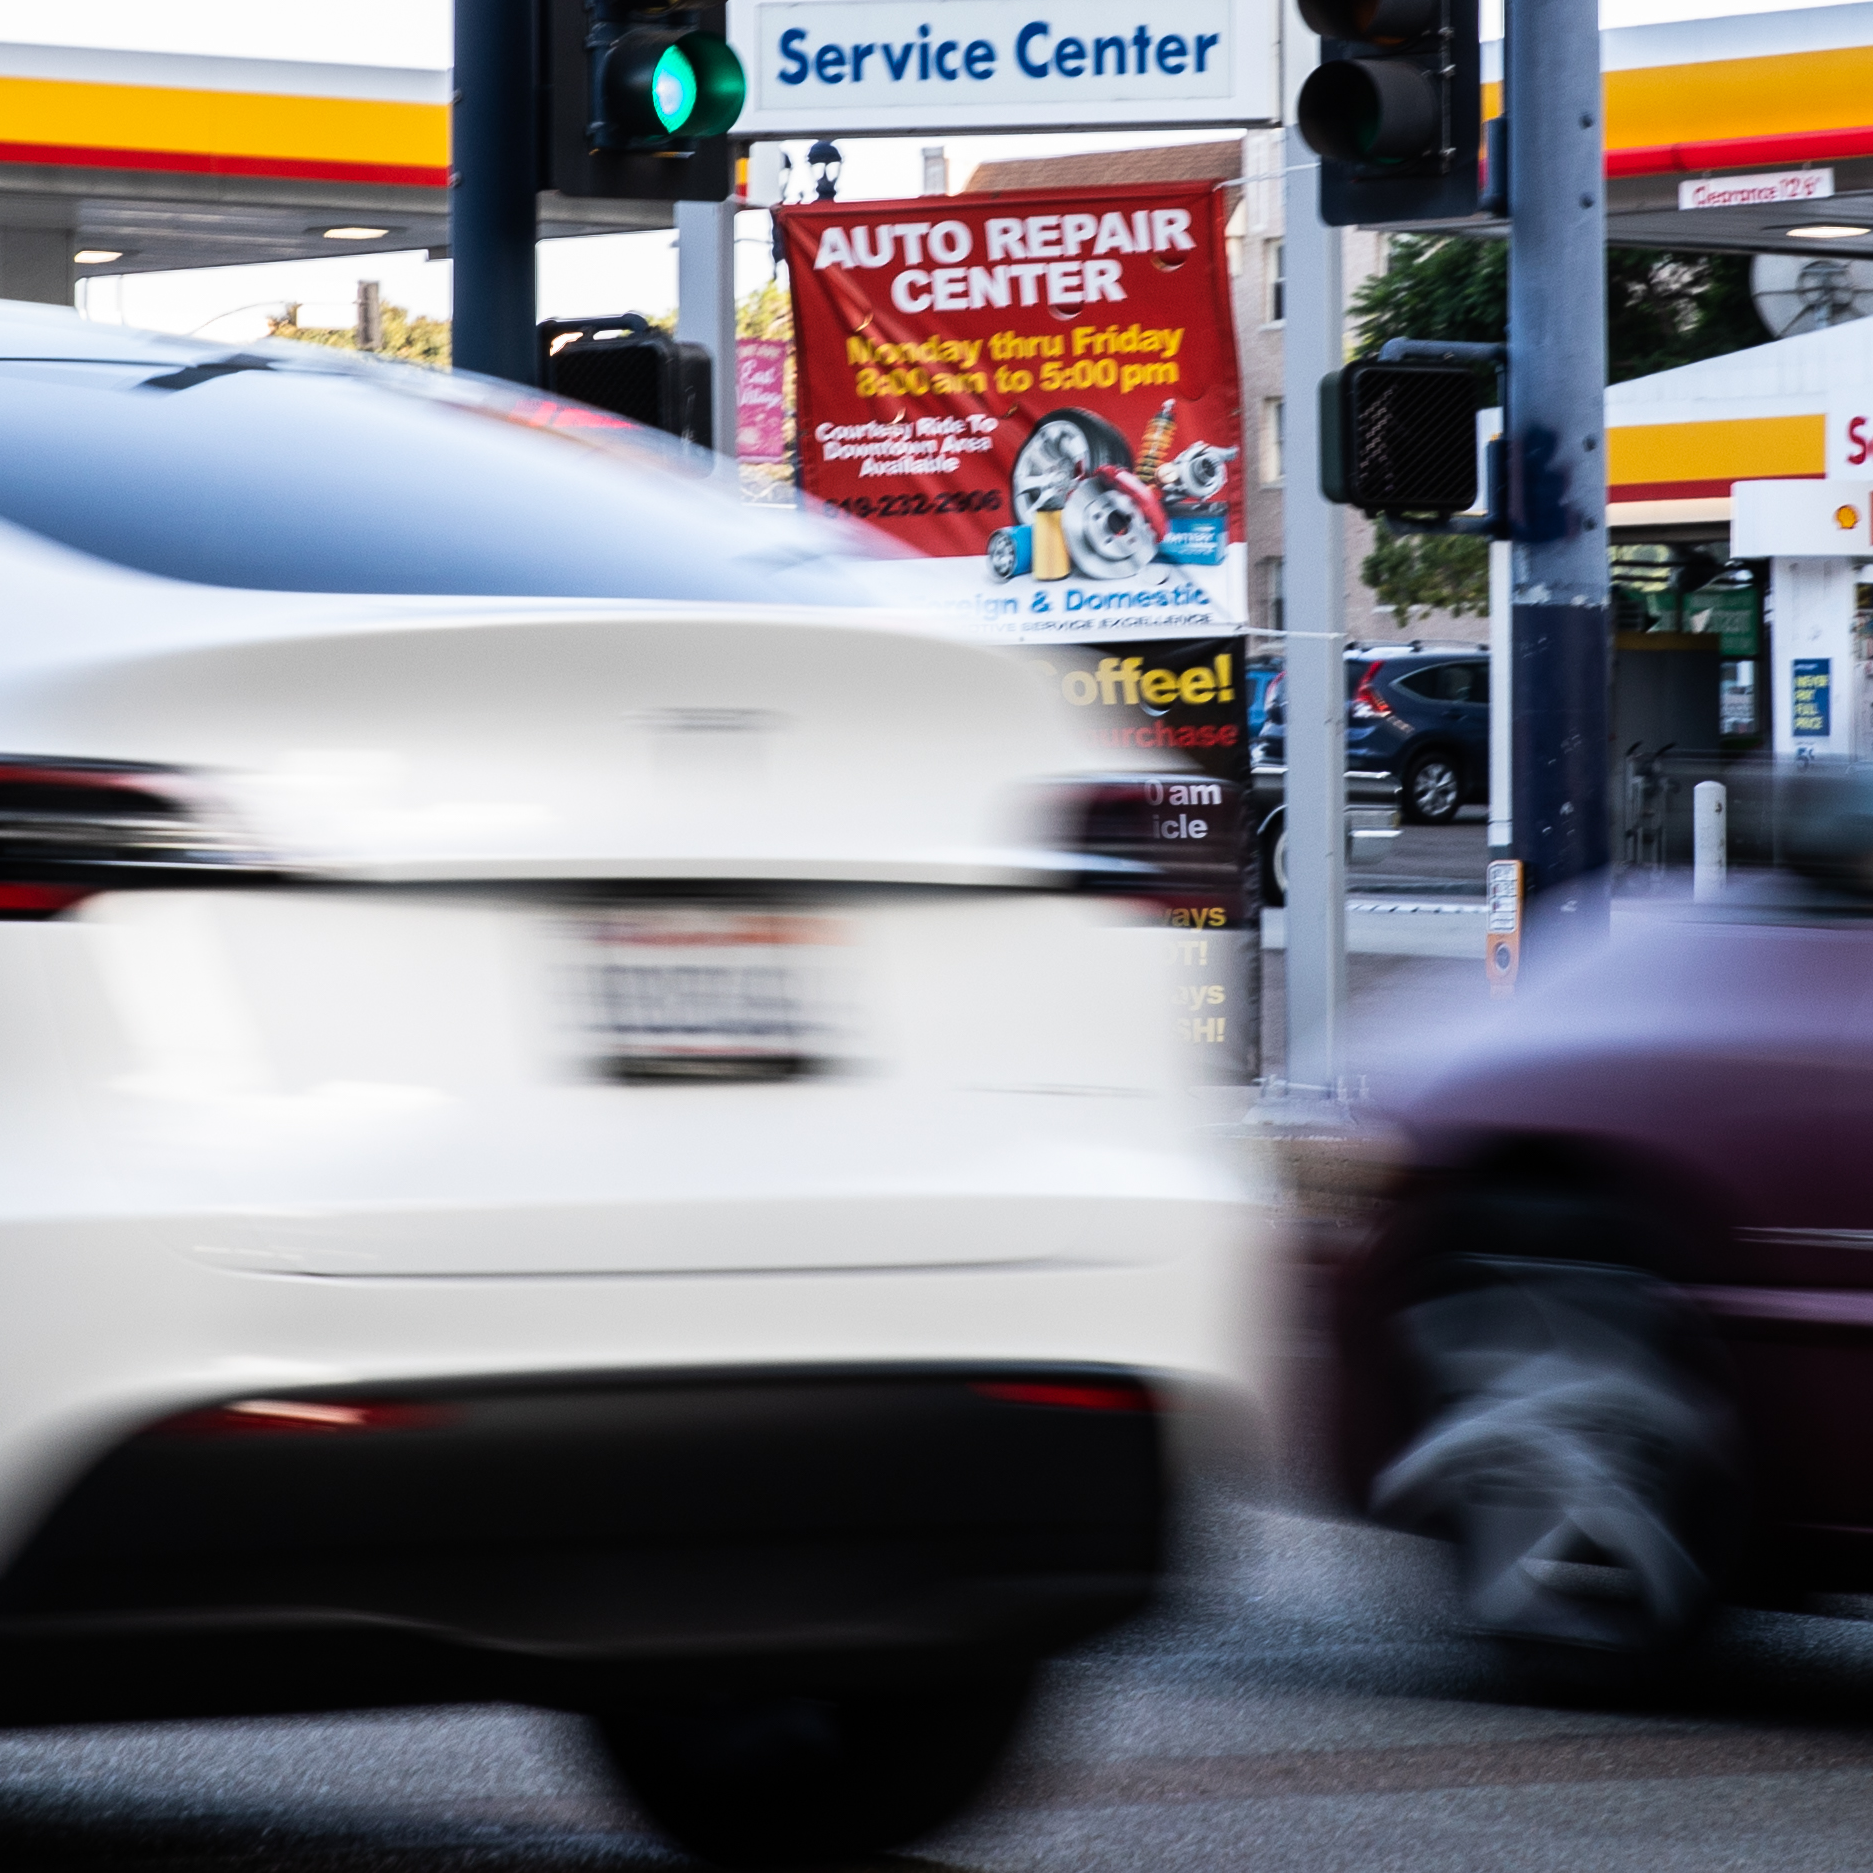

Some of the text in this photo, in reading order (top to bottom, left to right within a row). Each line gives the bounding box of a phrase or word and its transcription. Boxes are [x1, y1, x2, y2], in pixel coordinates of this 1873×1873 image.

[778, 22, 1220, 85] Service Center
[813, 208, 1197, 271] AUTO REPAIR
[890, 259, 1128, 315] CENTER
[845, 323, 1186, 370] Monday thru Friday
[930, 371, 988, 395] am
[993, 365, 1034, 394] to
[1039, 358, 1119, 392] 5:00
[1119, 360, 1180, 394] pm
[815, 419, 914, 443] Courtesy
[967, 413, 1000, 433] To
[940, 434, 994, 454] Area
[858, 453, 961, 479] Available
[935, 582, 1211, 622] oreign & Domestic
[1093, 718, 1239, 748] urchase
[1169, 783, 1223, 806] am
